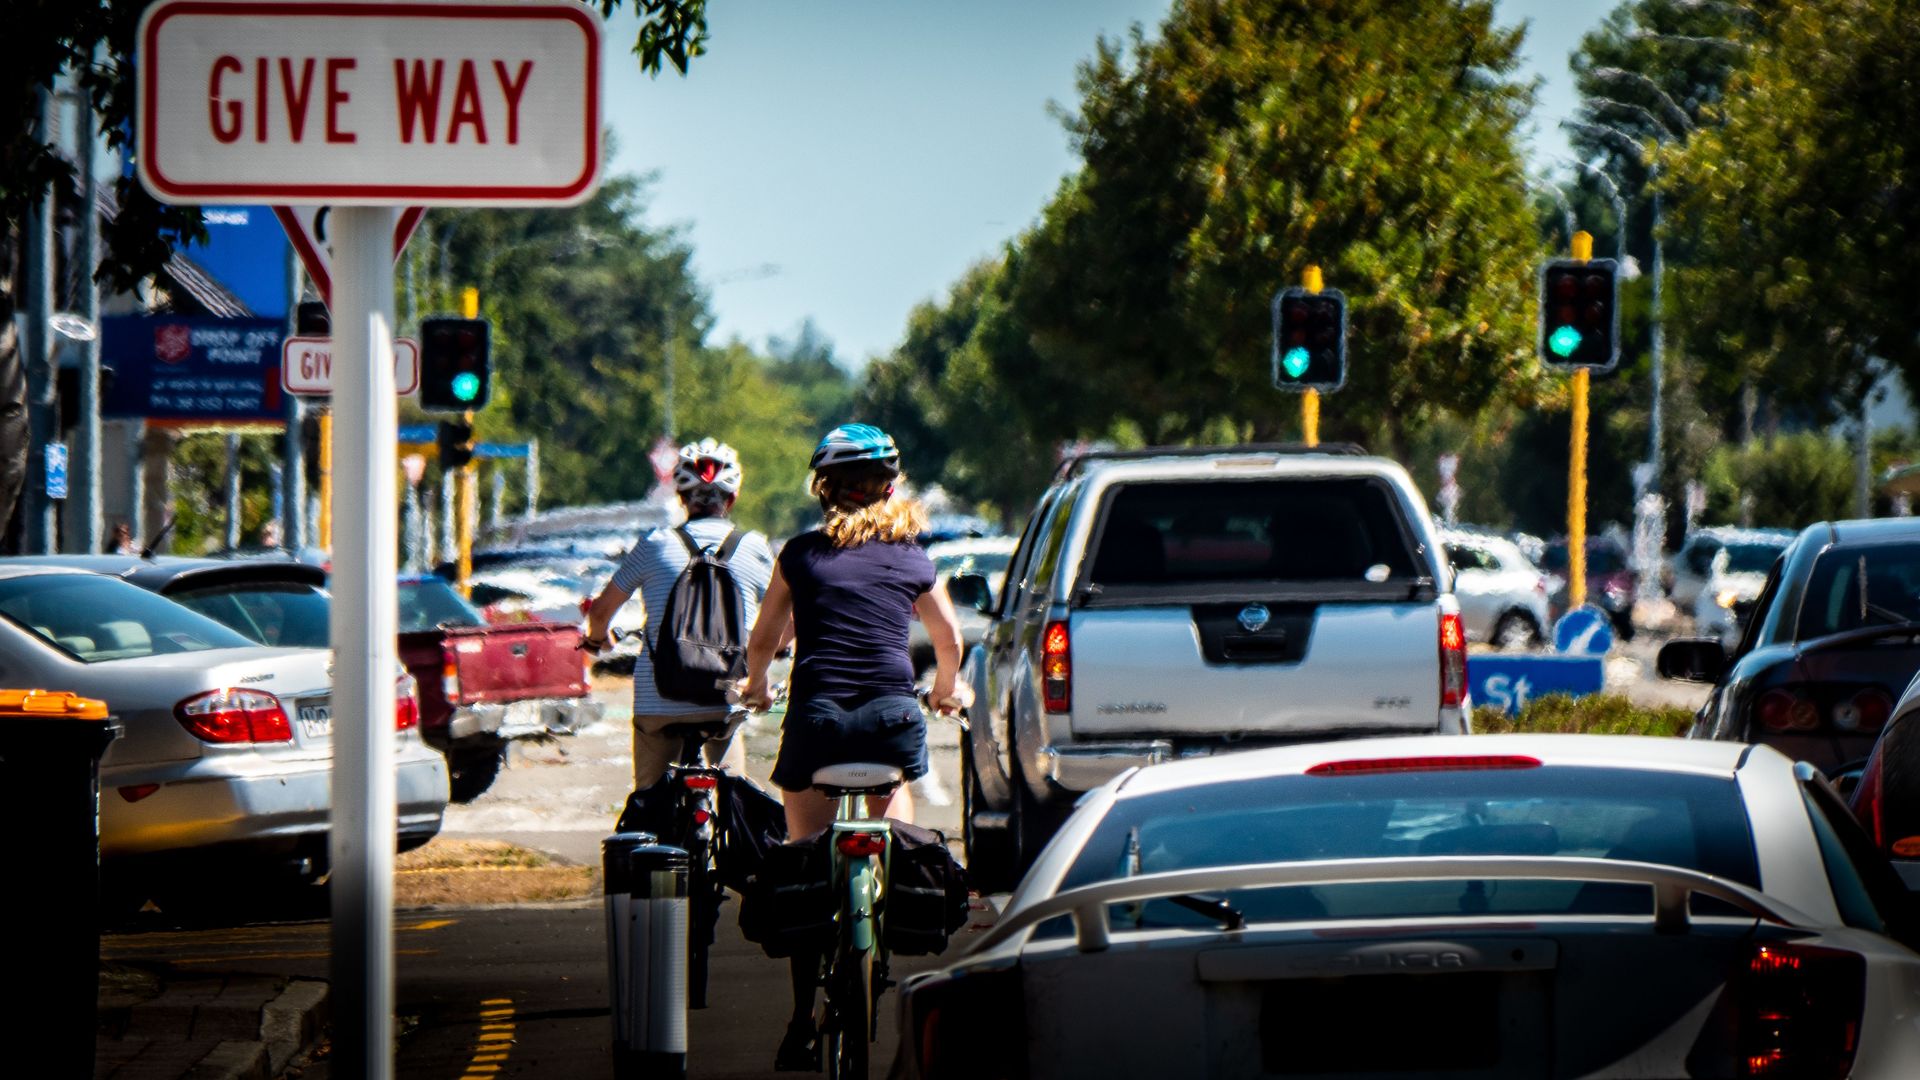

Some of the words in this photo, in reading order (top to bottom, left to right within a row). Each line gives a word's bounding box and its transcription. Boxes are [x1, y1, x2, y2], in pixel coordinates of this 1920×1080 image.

[208, 55, 357, 144] GIVE
[393, 58, 534, 144] WAY
[300, 351, 332, 380] GIV
[1484, 672, 1533, 711] St
